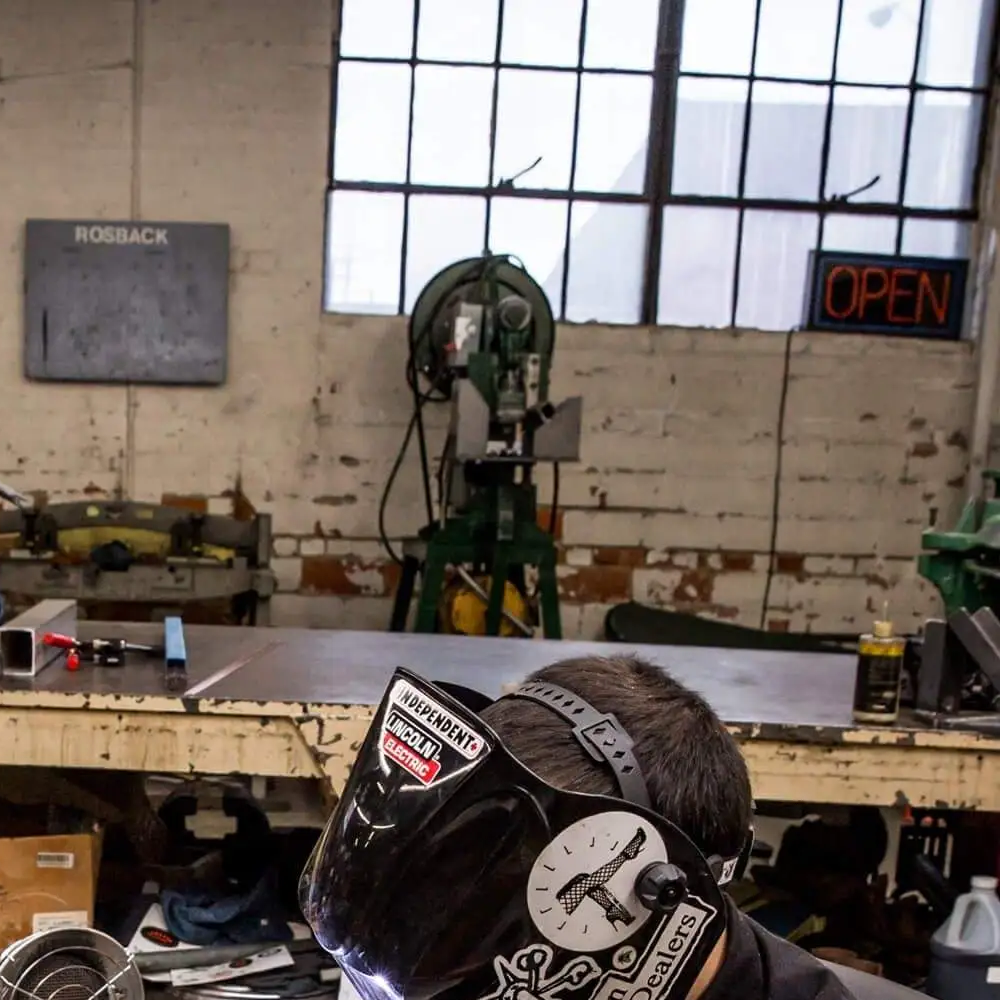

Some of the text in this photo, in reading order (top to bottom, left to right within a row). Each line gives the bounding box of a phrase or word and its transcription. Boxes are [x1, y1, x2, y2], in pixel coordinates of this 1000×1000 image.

[74, 225, 169, 245] ROSBACK
[824, 264, 952, 325] OPEN
[385, 714, 437, 760] LINCOLN
[398, 685, 475, 751] INDEPENDENT
[386, 738, 430, 777] ELECTRIC
